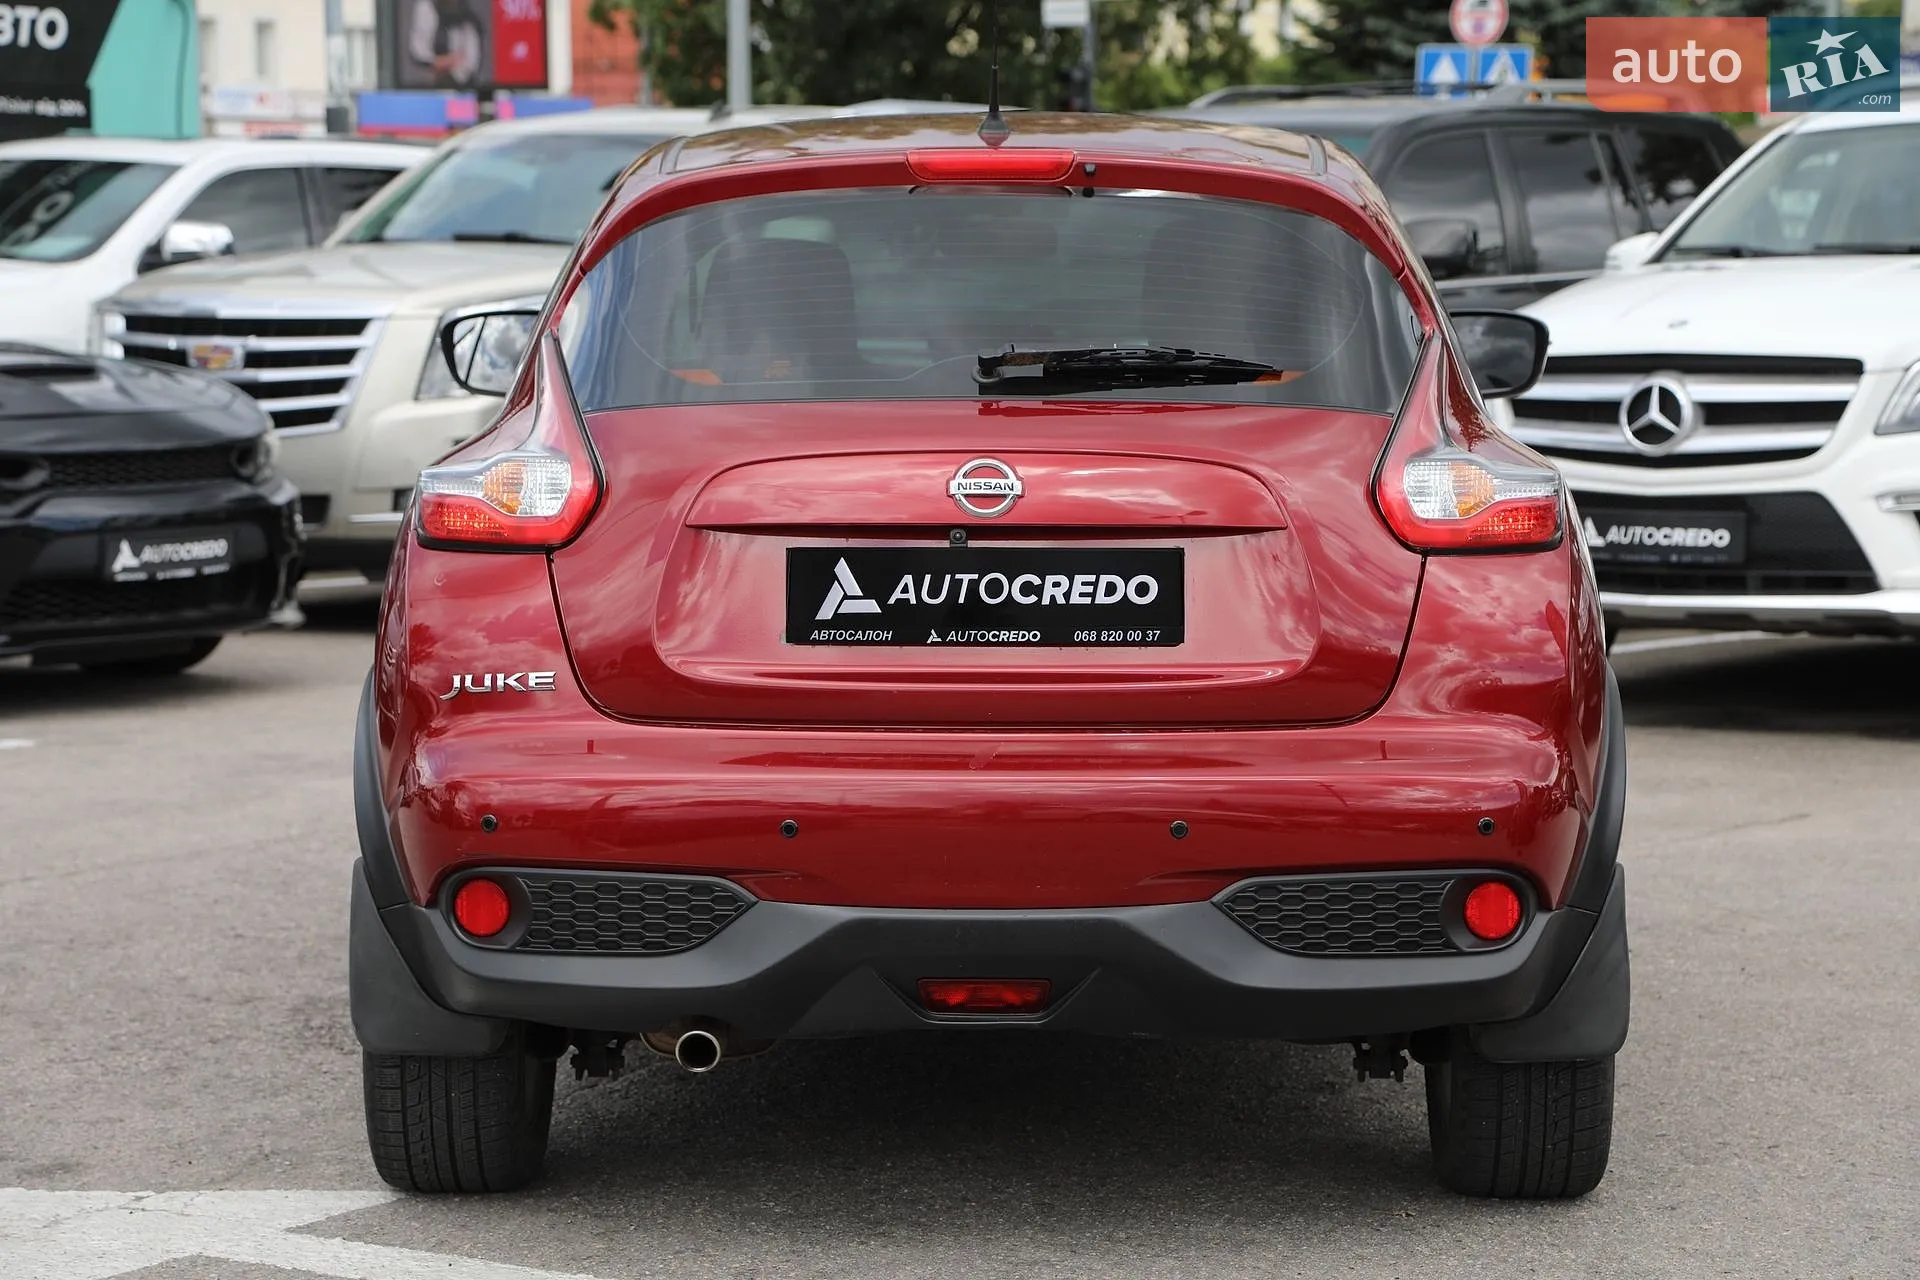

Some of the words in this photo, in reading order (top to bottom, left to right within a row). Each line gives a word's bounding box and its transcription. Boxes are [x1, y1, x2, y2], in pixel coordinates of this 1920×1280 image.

[957, 482, 1014, 491] NISSAN
[1605, 525, 1731, 548] AUTOCREDO
[886, 572, 1159, 606] AUTOCREDO
[809, 629, 893, 642] АВТОСАЛОН
[945, 630, 1041, 642] AUTOCREDO
[1073, 630, 1097, 642] 068
[1100, 630, 1124, 642] 820
[1126, 630, 1142, 642] 00
[1145, 630, 1161, 642] 37
[440, 671, 556, 700] JUKE
